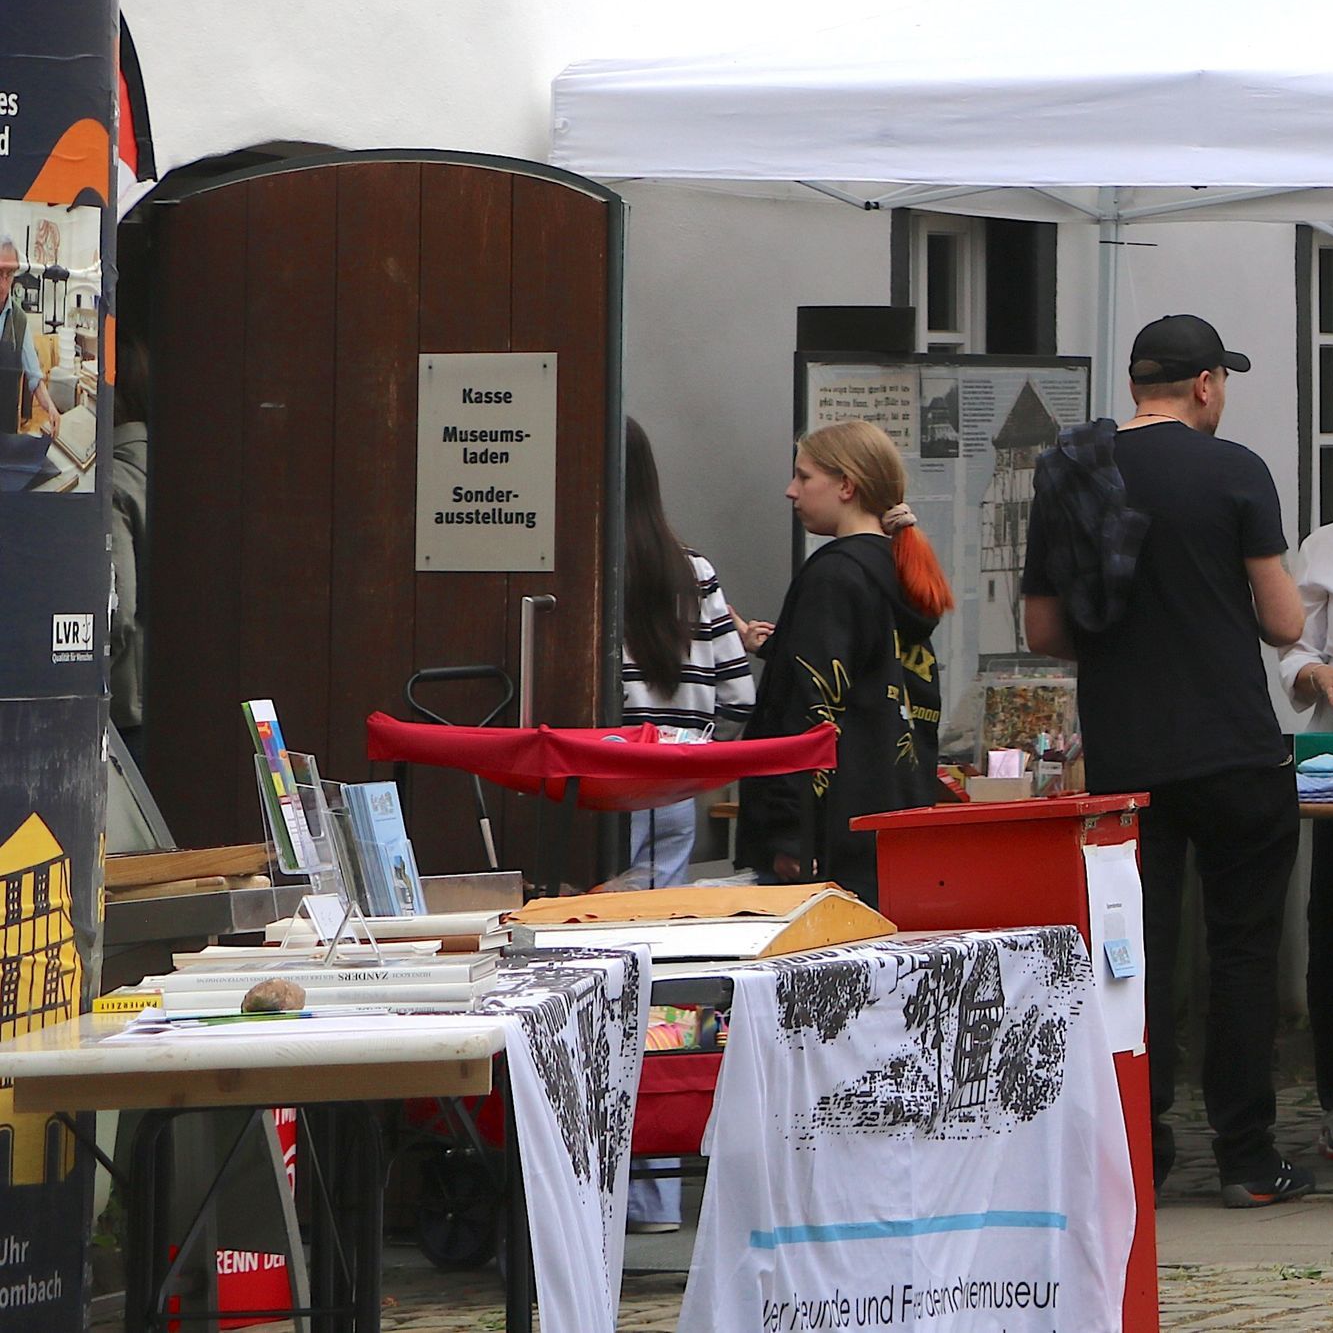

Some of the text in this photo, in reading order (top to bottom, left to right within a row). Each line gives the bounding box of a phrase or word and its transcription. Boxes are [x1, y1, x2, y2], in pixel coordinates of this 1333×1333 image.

[462, 388, 513, 404] Kasse
[442, 426, 531, 443] Museums-
[463, 447, 509, 464] laden
[452, 486, 519, 503] Sonder-
[434, 508, 536, 529] ausstellung
[56, 621, 80, 644] LVR
[338, 971, 389, 981] ZANDERS
[856, 1284, 894, 1327] und
